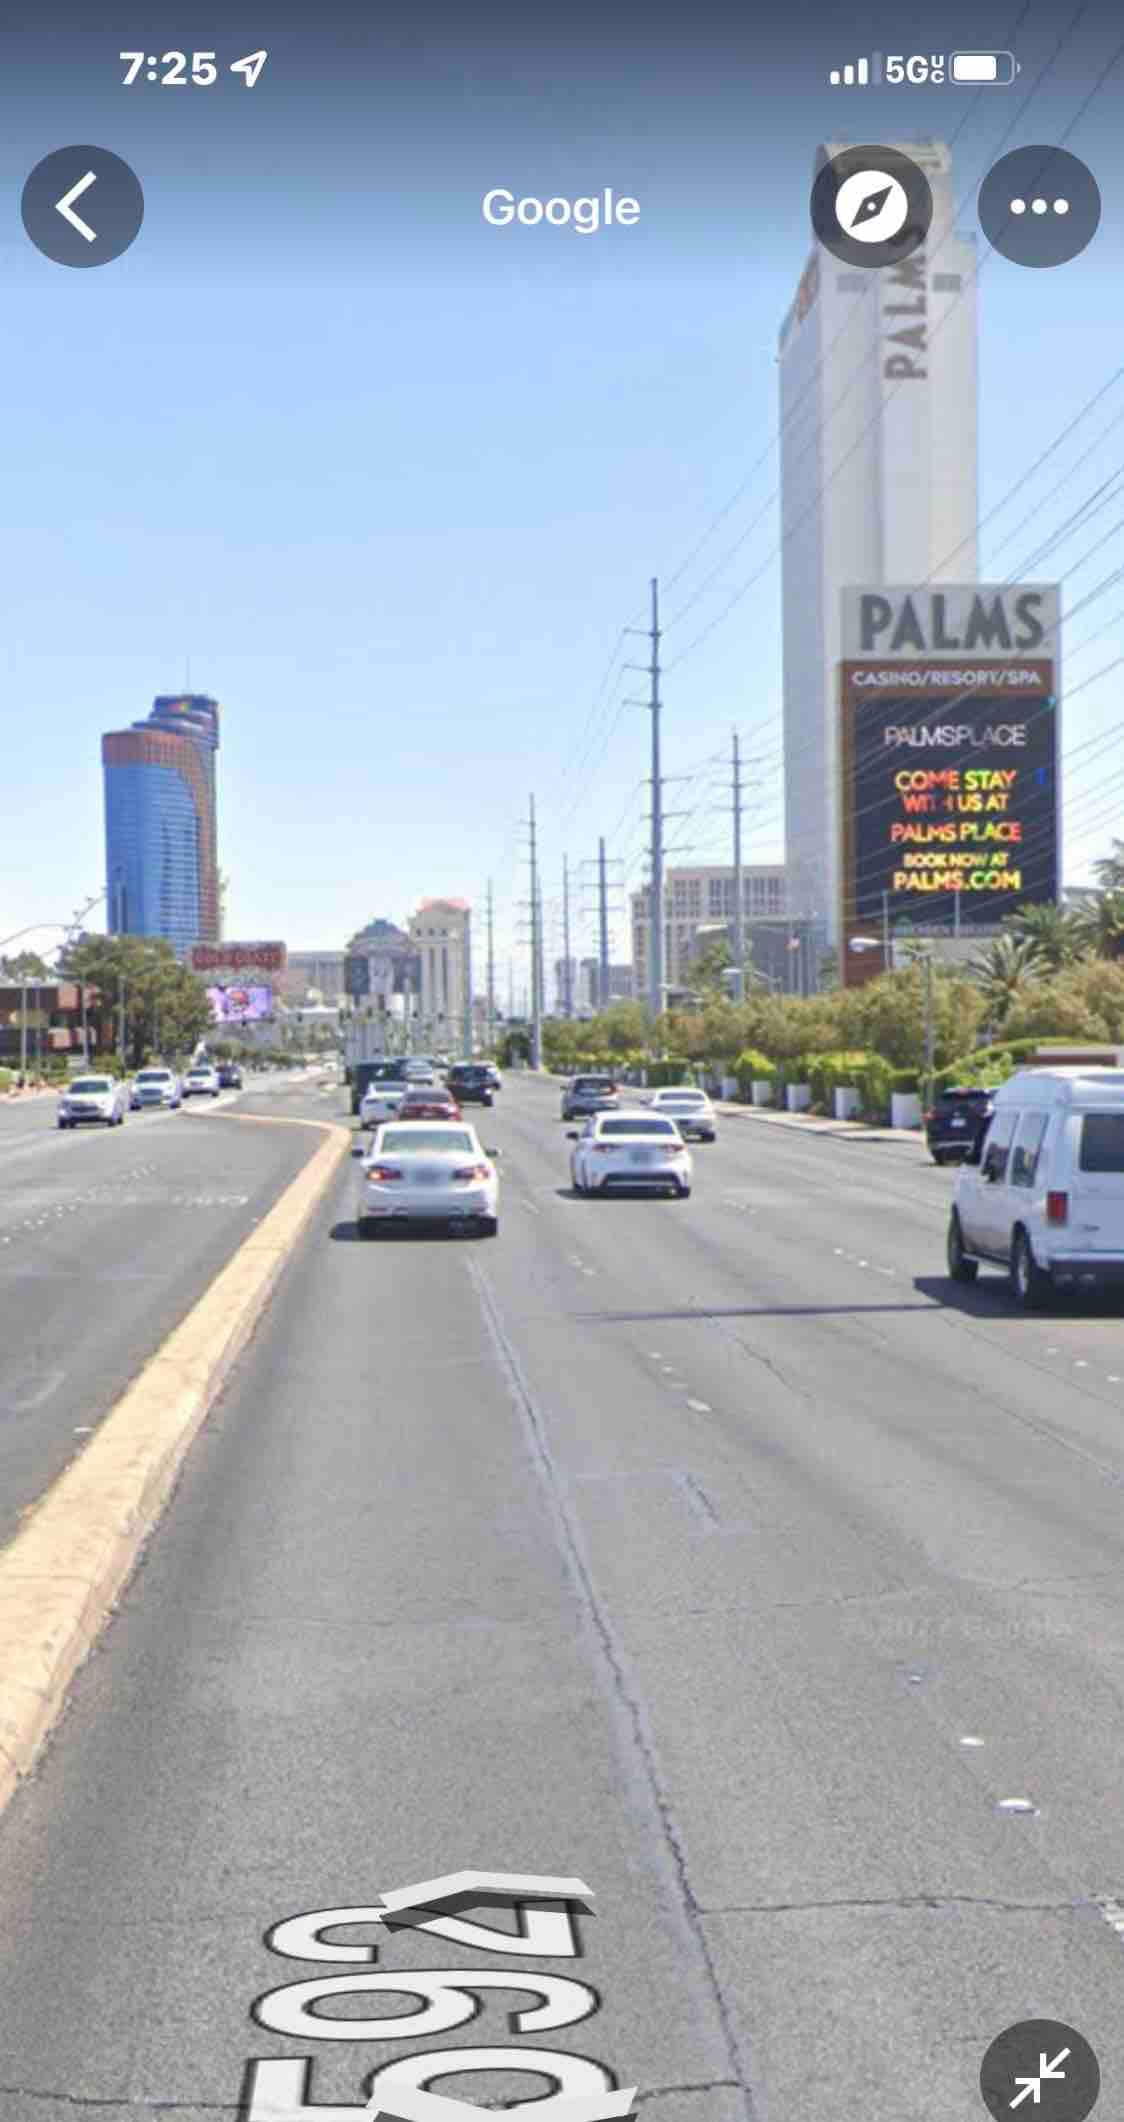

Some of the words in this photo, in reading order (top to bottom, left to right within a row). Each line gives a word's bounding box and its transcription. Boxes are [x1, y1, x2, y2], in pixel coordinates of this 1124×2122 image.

[860, 593, 1044, 651] PALMS
[895, 770, 960, 791] COME
[964, 769, 1017, 791] STAY
[957, 792, 983, 812] US
[986, 792, 1009, 812] AT
[890, 822, 957, 843] PALMS
[960, 821, 1022, 843] PLACE
[903, 851, 948, 868] BOOK
[948, 851, 989, 868] NOW
[990, 851, 1009, 868] AT
[893, 870, 1021, 891] PALMS.COM
